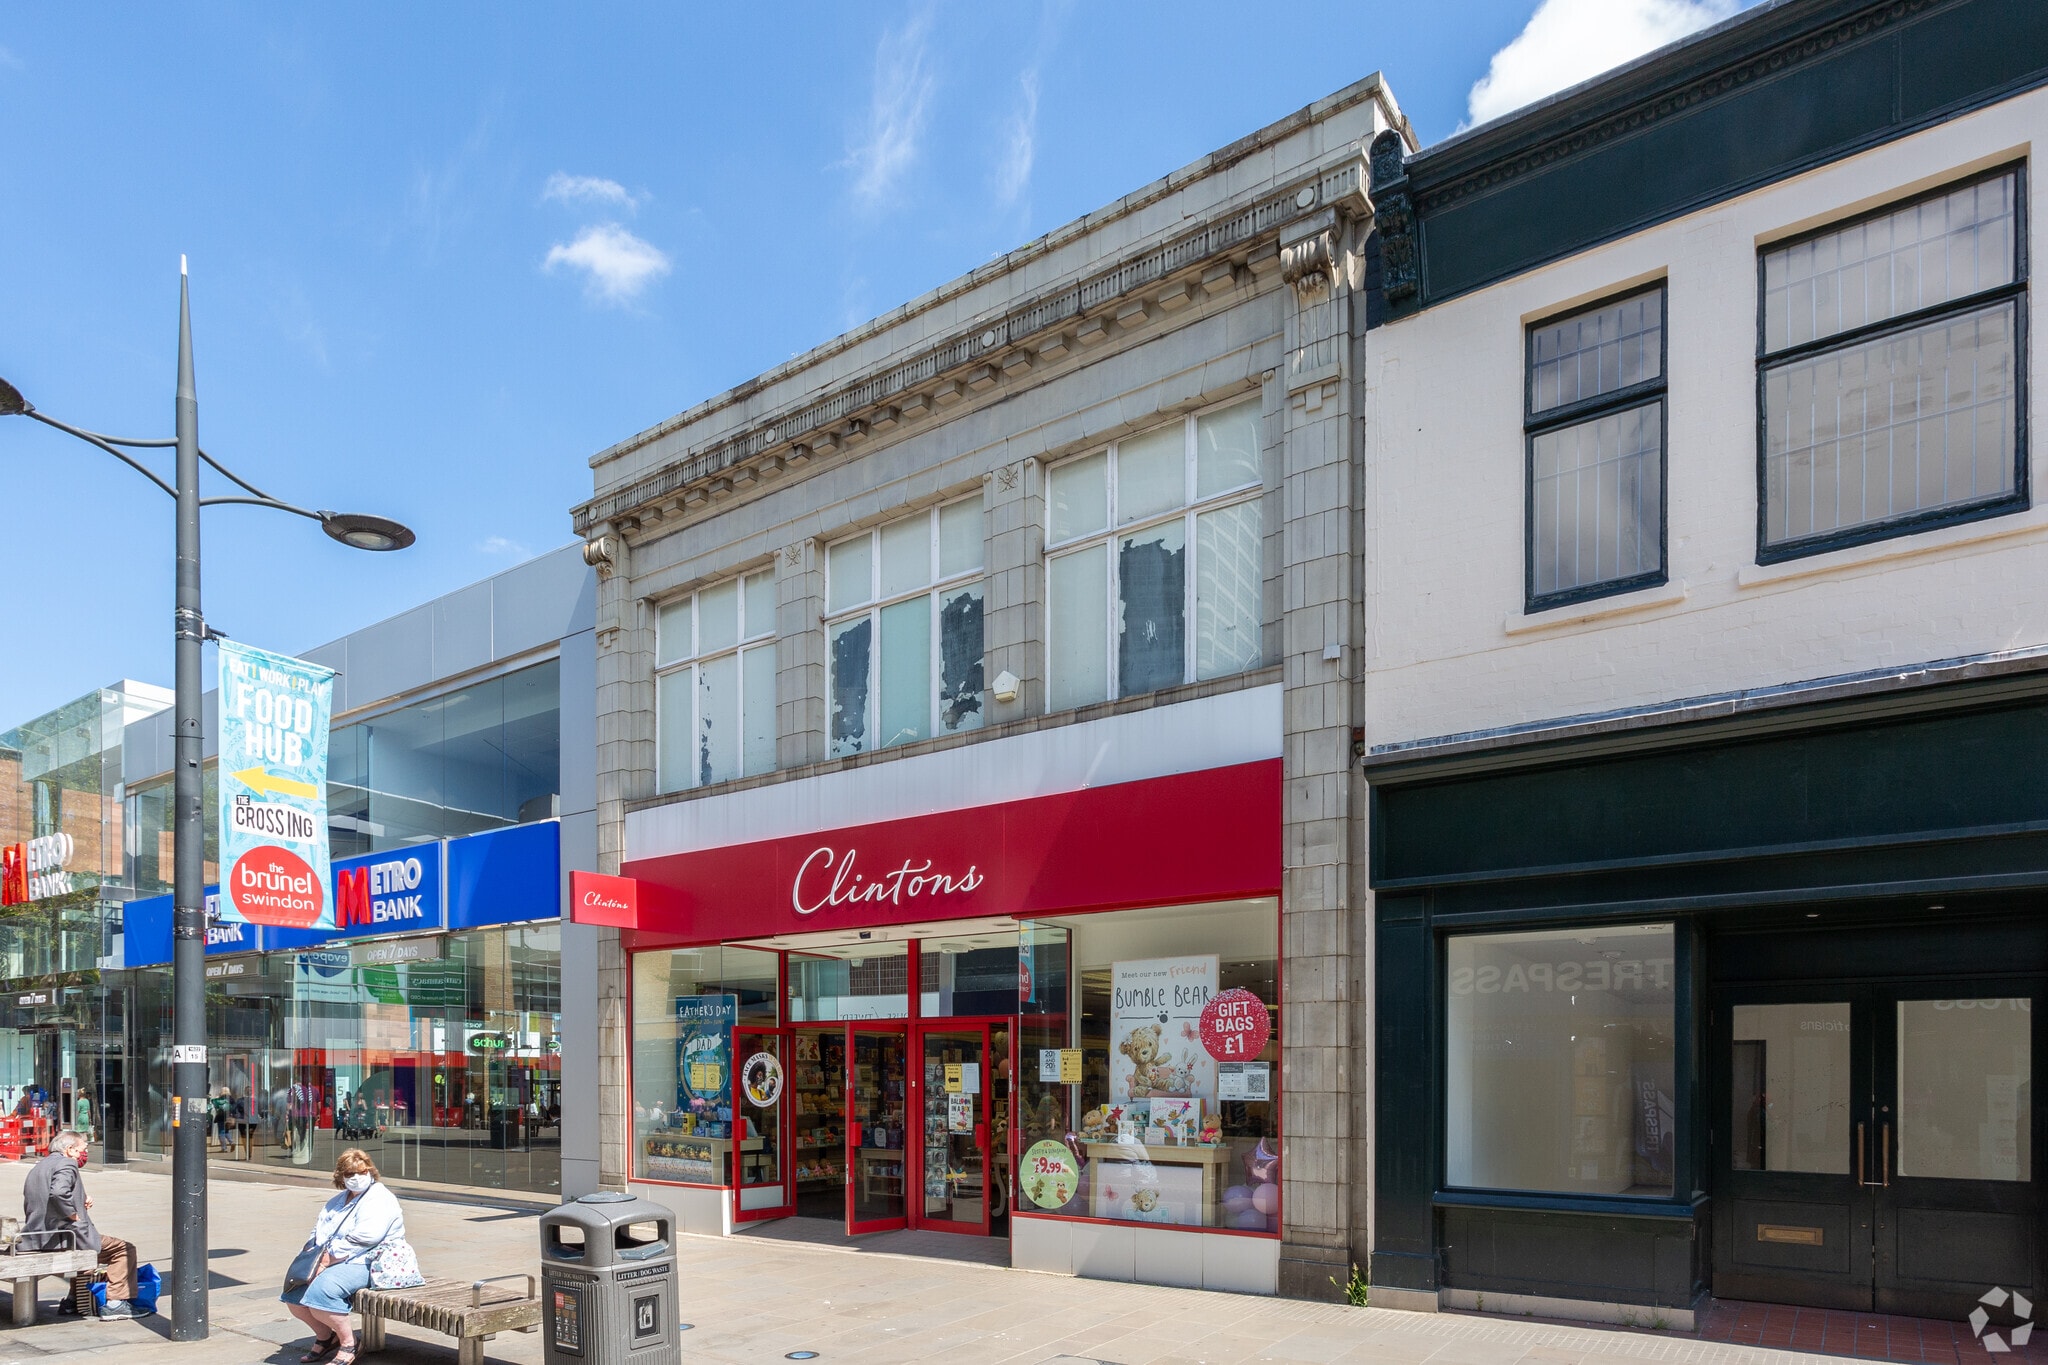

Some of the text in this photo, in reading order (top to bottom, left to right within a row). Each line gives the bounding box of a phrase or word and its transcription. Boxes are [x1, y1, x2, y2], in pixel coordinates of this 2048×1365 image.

[229, 658, 325, 697] EAT WORK PLAY
[237, 682, 313, 734] FOOD
[245, 720, 303, 767] HUB
[237, 795, 250, 805] THE
[236, 807, 313, 838] CROSSING
[268, 862, 284, 874] the
[28, 871, 70, 900] BANK
[241, 862, 313, 895] brunel
[793, 847, 984, 915] Clintons
[336, 857, 422, 927] METRO
[584, 891, 628, 909] Clintons
[242, 892, 315, 911] swindon
[373, 895, 423, 923] BANK
[207, 922, 244, 945] BANK
[367, 944, 418, 961] OPEN 7 DAYS
[206, 962, 244, 977] OPEN 7 DAYS
[1169, 962, 1207, 979] Friend
[679, 1004, 731, 1018] FATHER'S DAY
[1218, 1000, 1250, 1017] GIFT
[1215, 1016, 1255, 1033] BAGS
[696, 1038, 712, 1050] DAD
[1224, 1033, 1245, 1055] £1
[174, 1049, 182, 1059] A
[1034, 1156, 1062, 1174] £9.99
[617, 1265, 669, 1280] LITTER DOG WASTE
